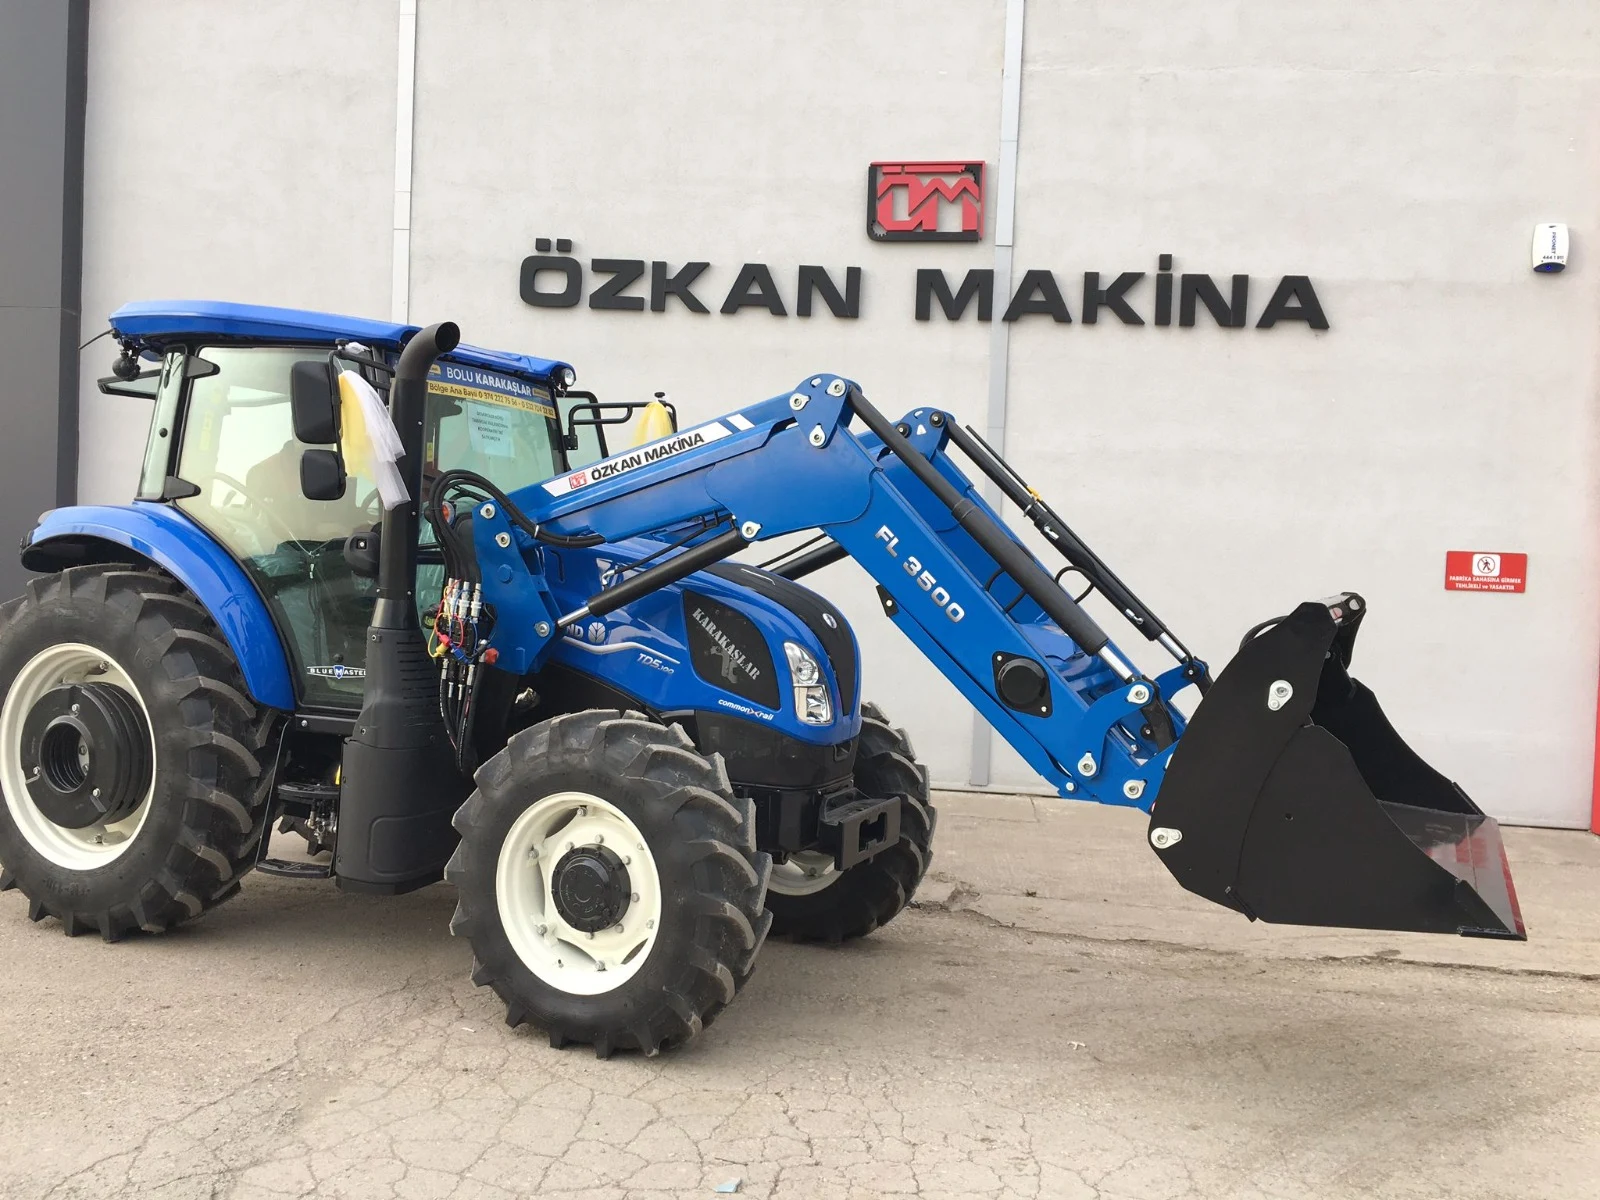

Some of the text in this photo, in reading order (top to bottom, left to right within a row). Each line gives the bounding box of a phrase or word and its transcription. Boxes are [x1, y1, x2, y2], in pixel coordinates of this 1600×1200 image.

[519, 237, 1330, 329] ÖZKAN MAKİNA
[429, 382, 448, 393] Bölge
[450, 386, 462, 395] Ana
[446, 366, 473, 382] BOLU
[475, 373, 532, 396] KARAKAŞLAR
[591, 453, 642, 481] ÖZKAN
[644, 432, 705, 463] MAKİNA
[875, 525, 965, 623] FL 3500
